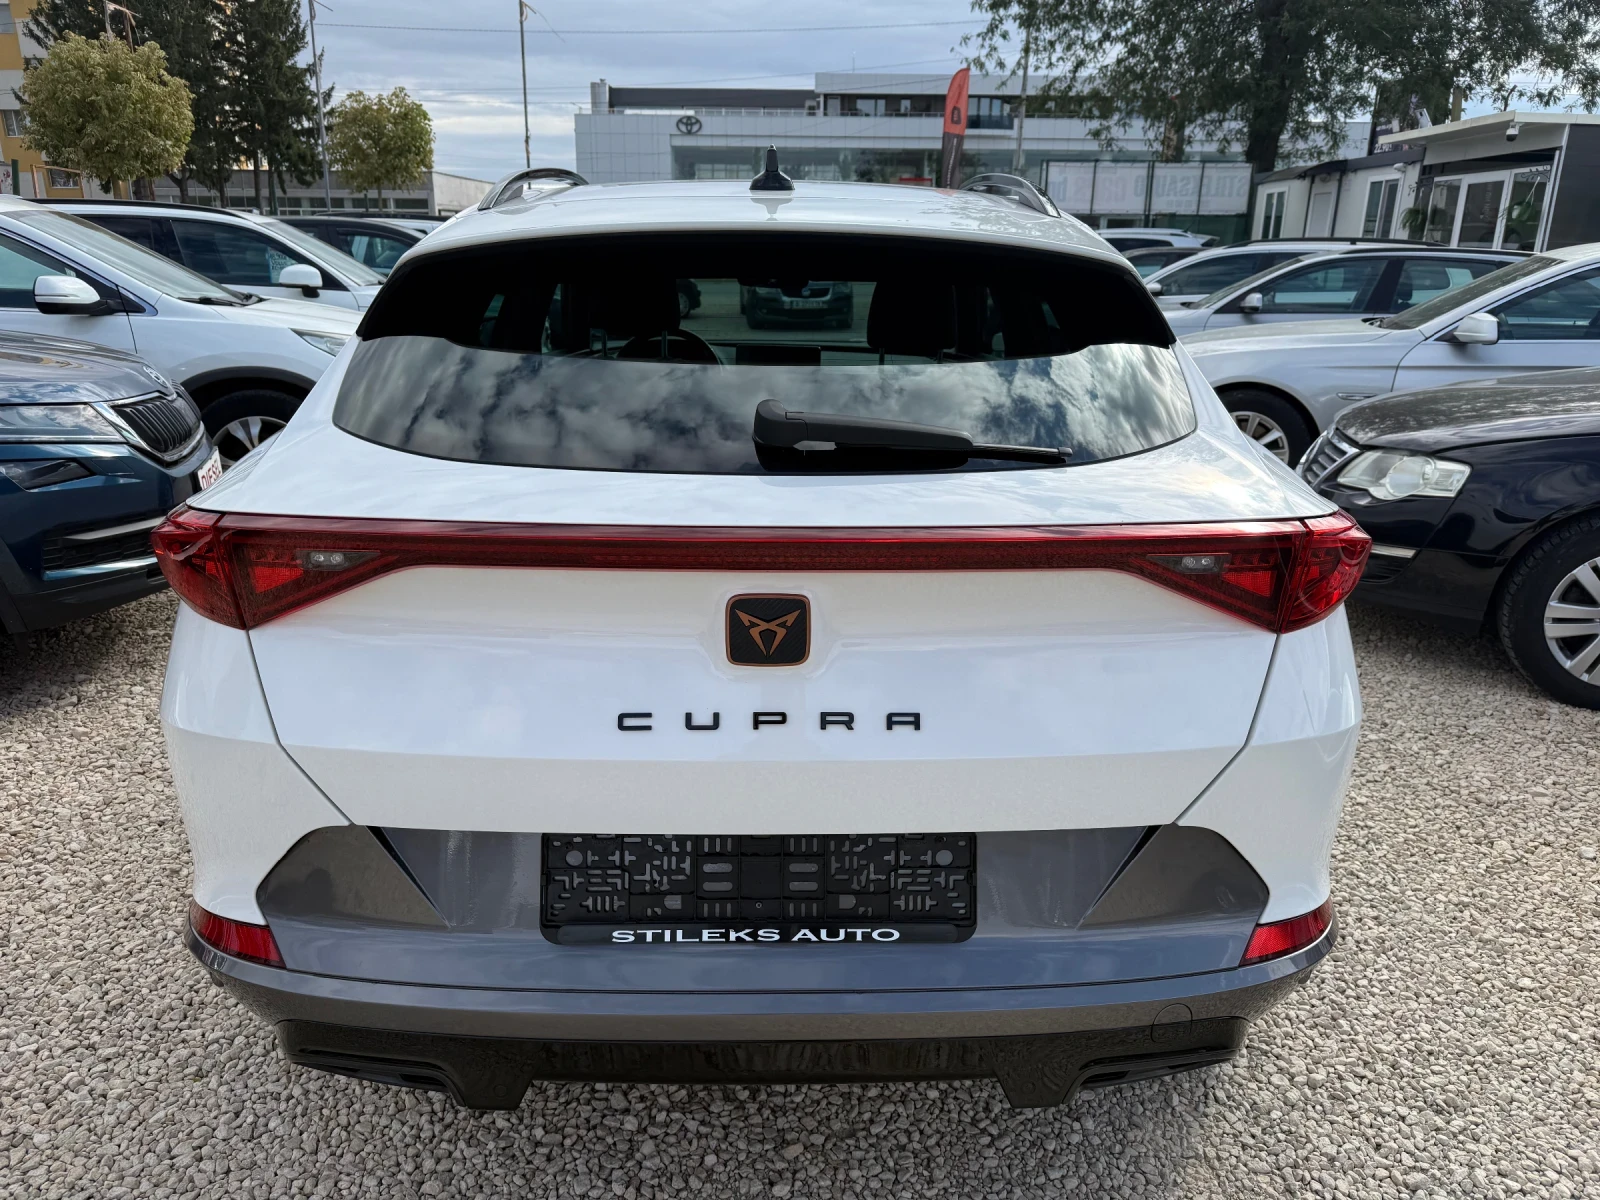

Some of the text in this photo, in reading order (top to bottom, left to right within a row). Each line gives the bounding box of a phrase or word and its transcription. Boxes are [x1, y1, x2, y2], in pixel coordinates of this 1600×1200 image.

[617, 711, 921, 731] CUPRA
[611, 927, 901, 943] STILEKS AUTO
